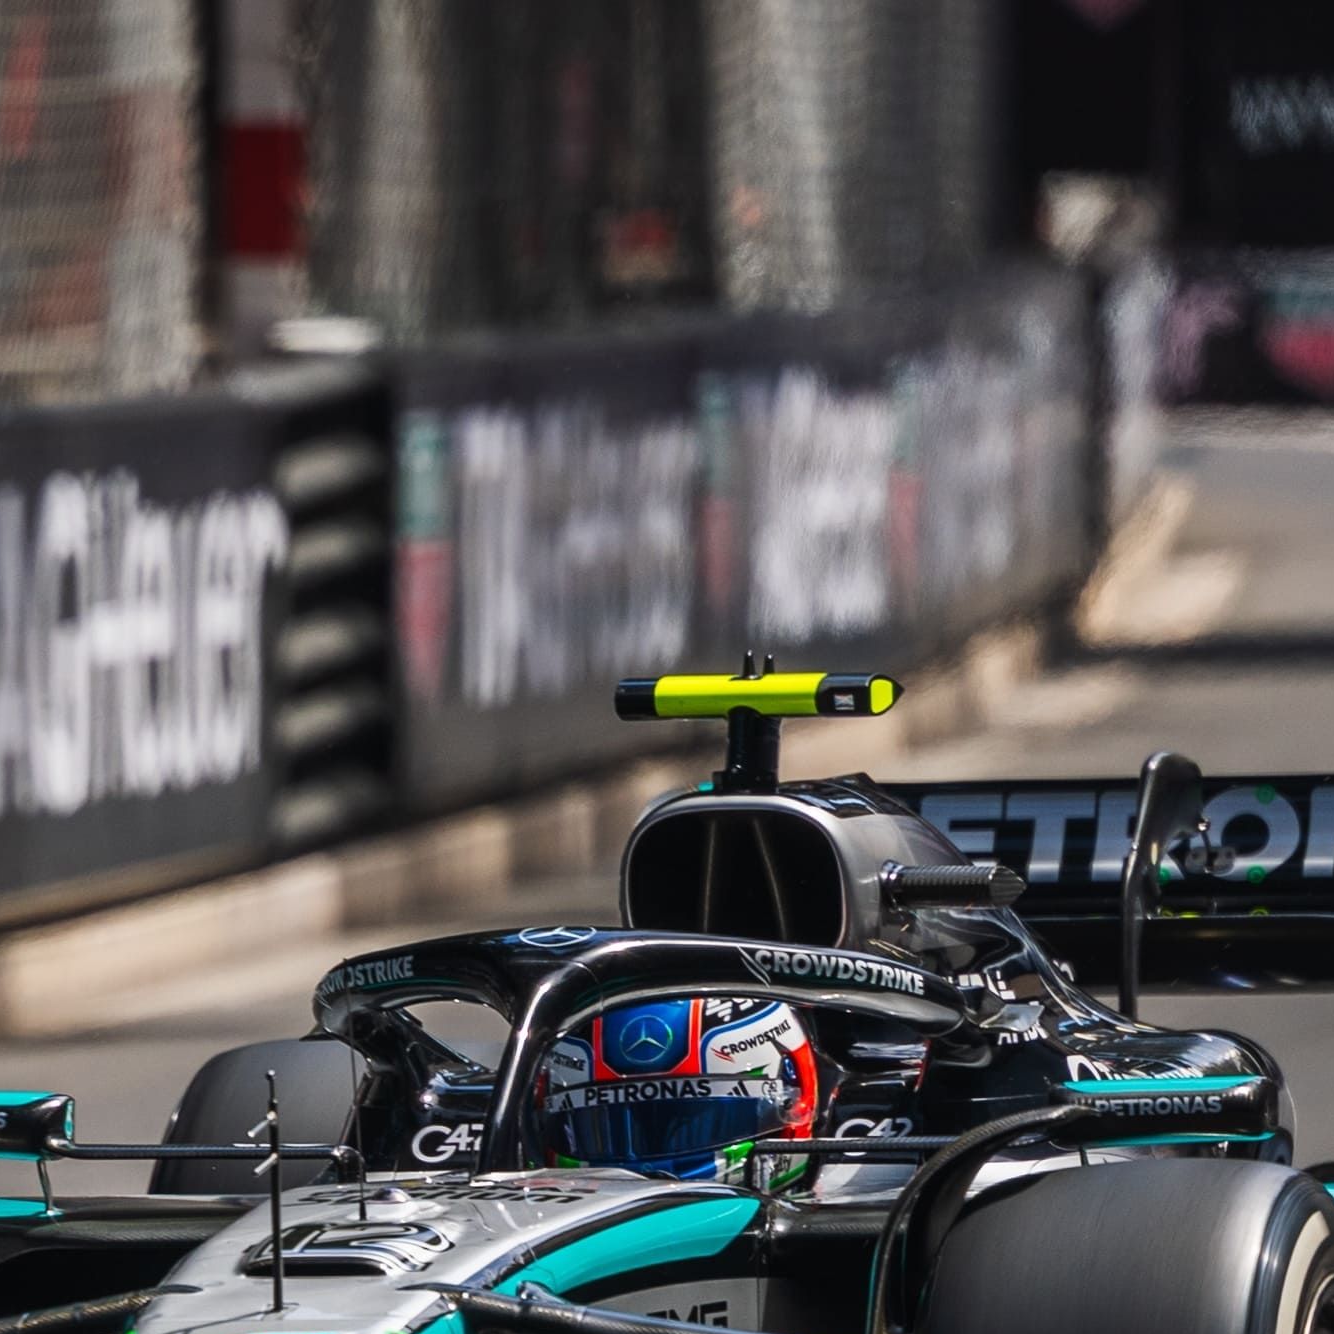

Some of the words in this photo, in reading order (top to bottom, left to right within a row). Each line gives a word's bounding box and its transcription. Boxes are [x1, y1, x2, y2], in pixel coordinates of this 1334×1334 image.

[754, 949, 926, 996] CROWDSTRIKE
[584, 1078, 712, 1106] PETRONAS
[1095, 1096, 1223, 1117] PETRONAS
